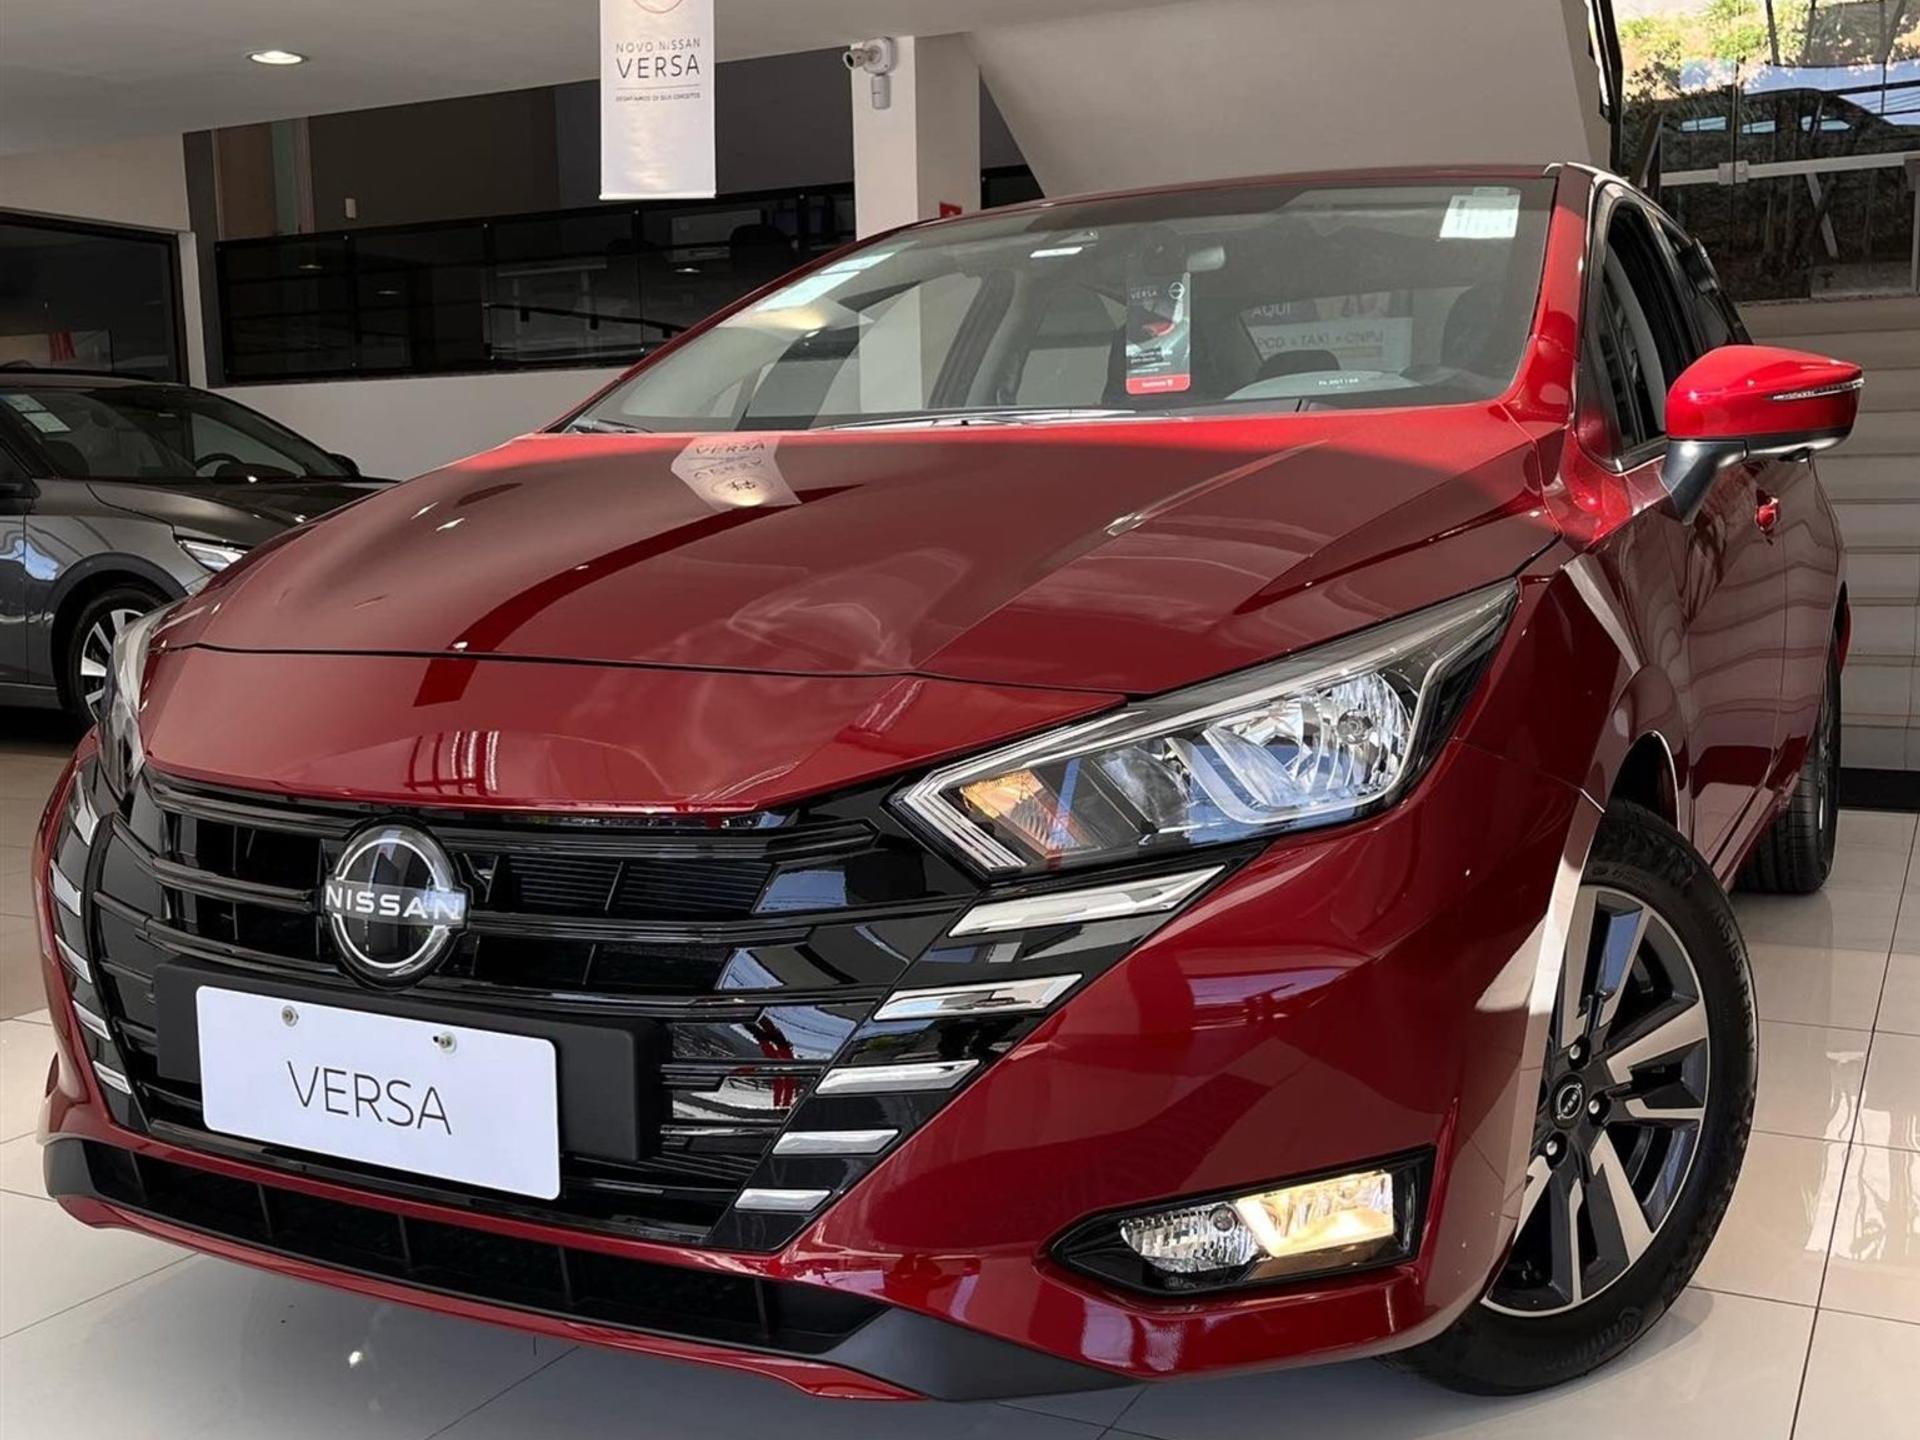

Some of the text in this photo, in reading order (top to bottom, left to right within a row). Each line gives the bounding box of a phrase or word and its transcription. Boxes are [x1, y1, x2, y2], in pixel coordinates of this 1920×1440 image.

[616, 38, 701, 53] NOVO NISSAN
[616, 54, 701, 79] VERSA
[325, 885, 462, 920] NISSAN
[286, 1060, 452, 1136] VERSA
